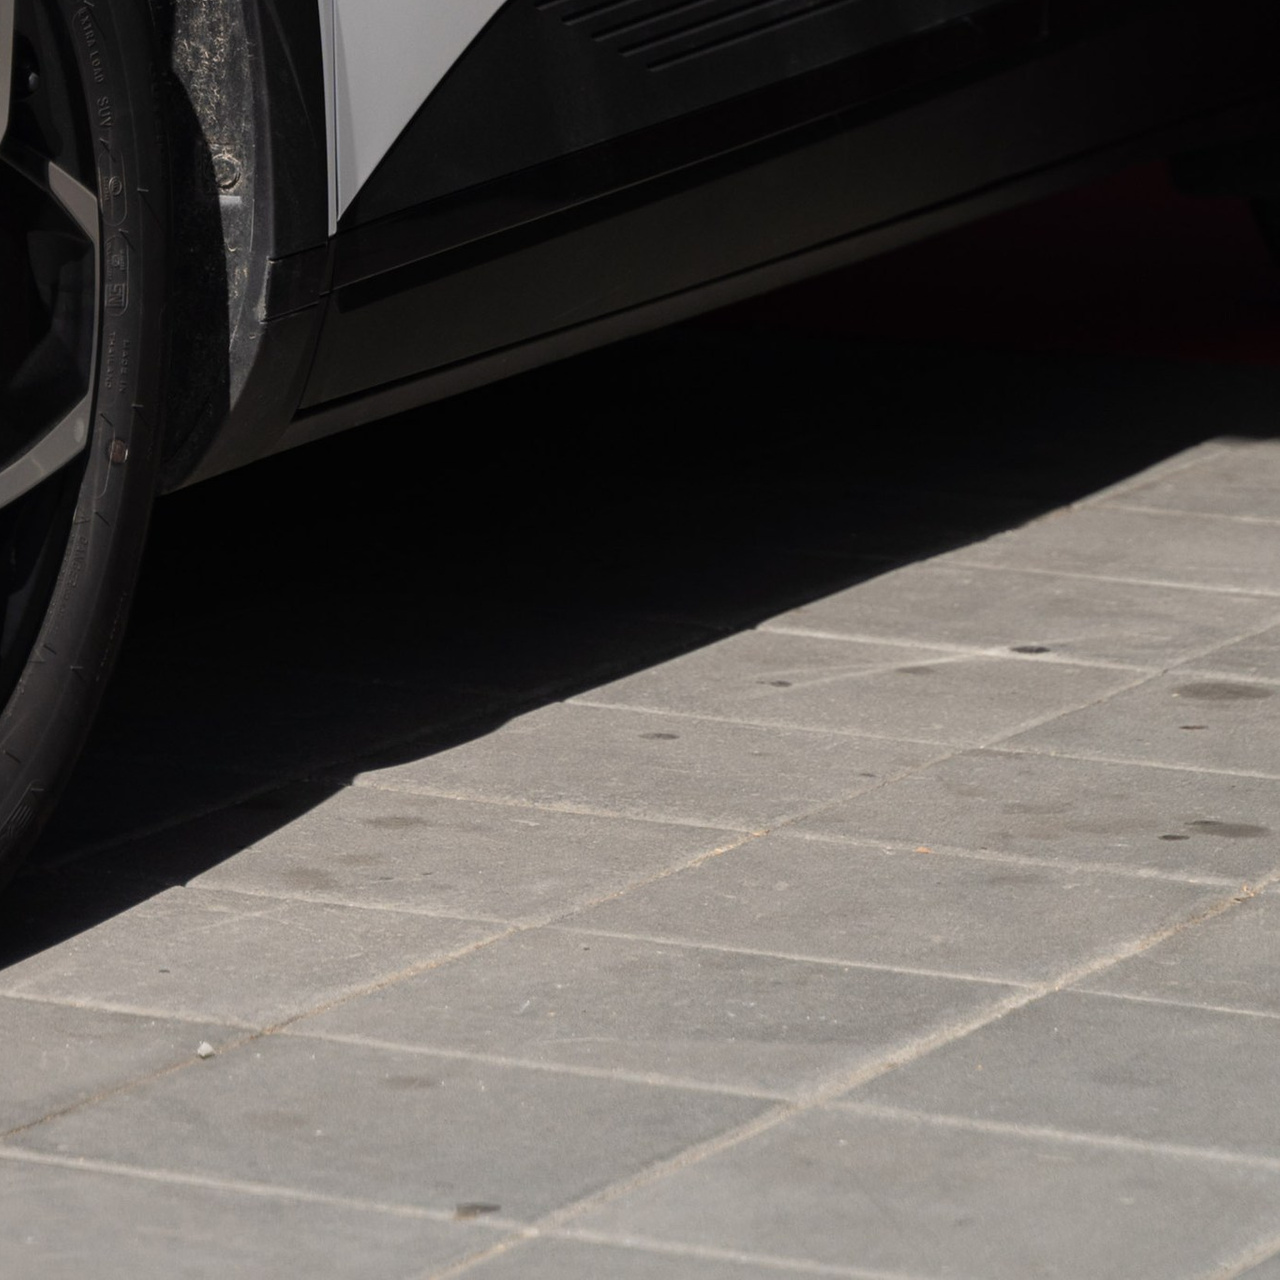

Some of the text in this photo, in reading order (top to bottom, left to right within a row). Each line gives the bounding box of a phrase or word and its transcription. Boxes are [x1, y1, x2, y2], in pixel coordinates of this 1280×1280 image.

[80, 9, 113, 128] EXTRA LOAD SUV
